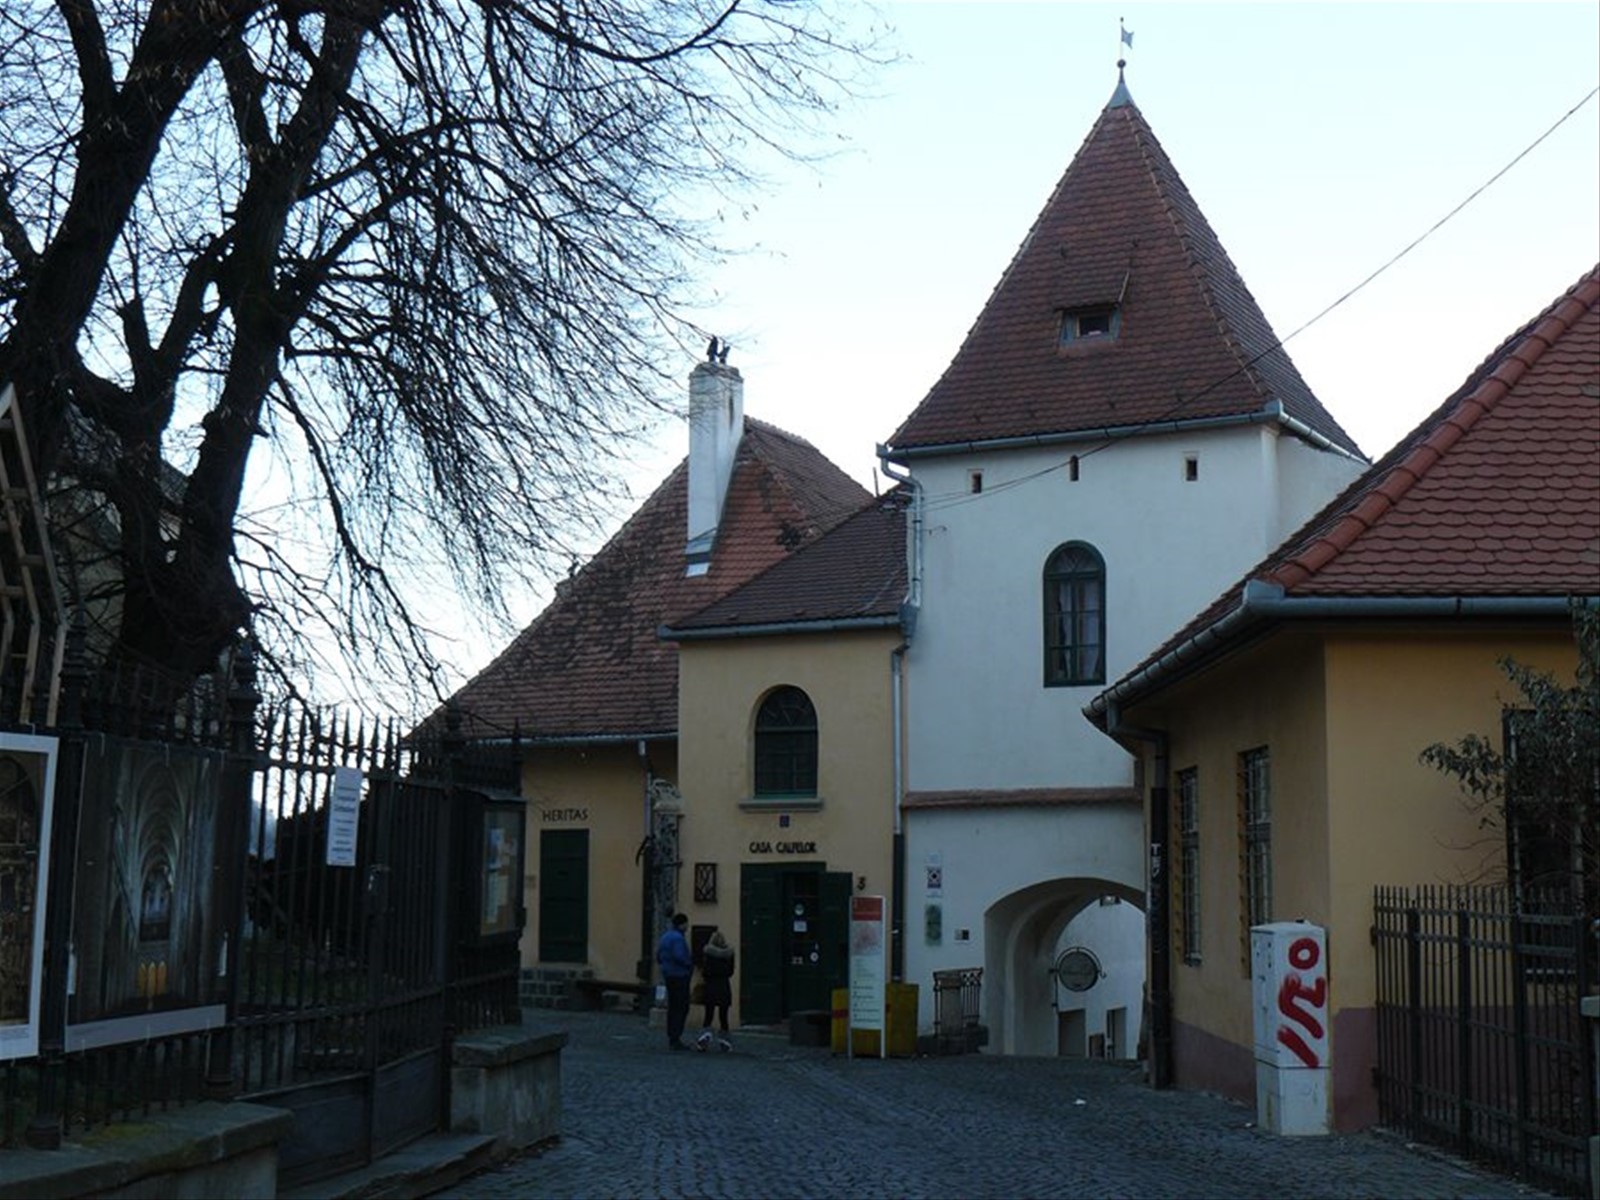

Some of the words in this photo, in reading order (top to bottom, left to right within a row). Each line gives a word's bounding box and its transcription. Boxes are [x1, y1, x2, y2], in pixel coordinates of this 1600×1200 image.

[542, 807, 588, 821] HERITAS
[749, 841, 773, 854] CASA
[857, 876, 867, 891] 3
